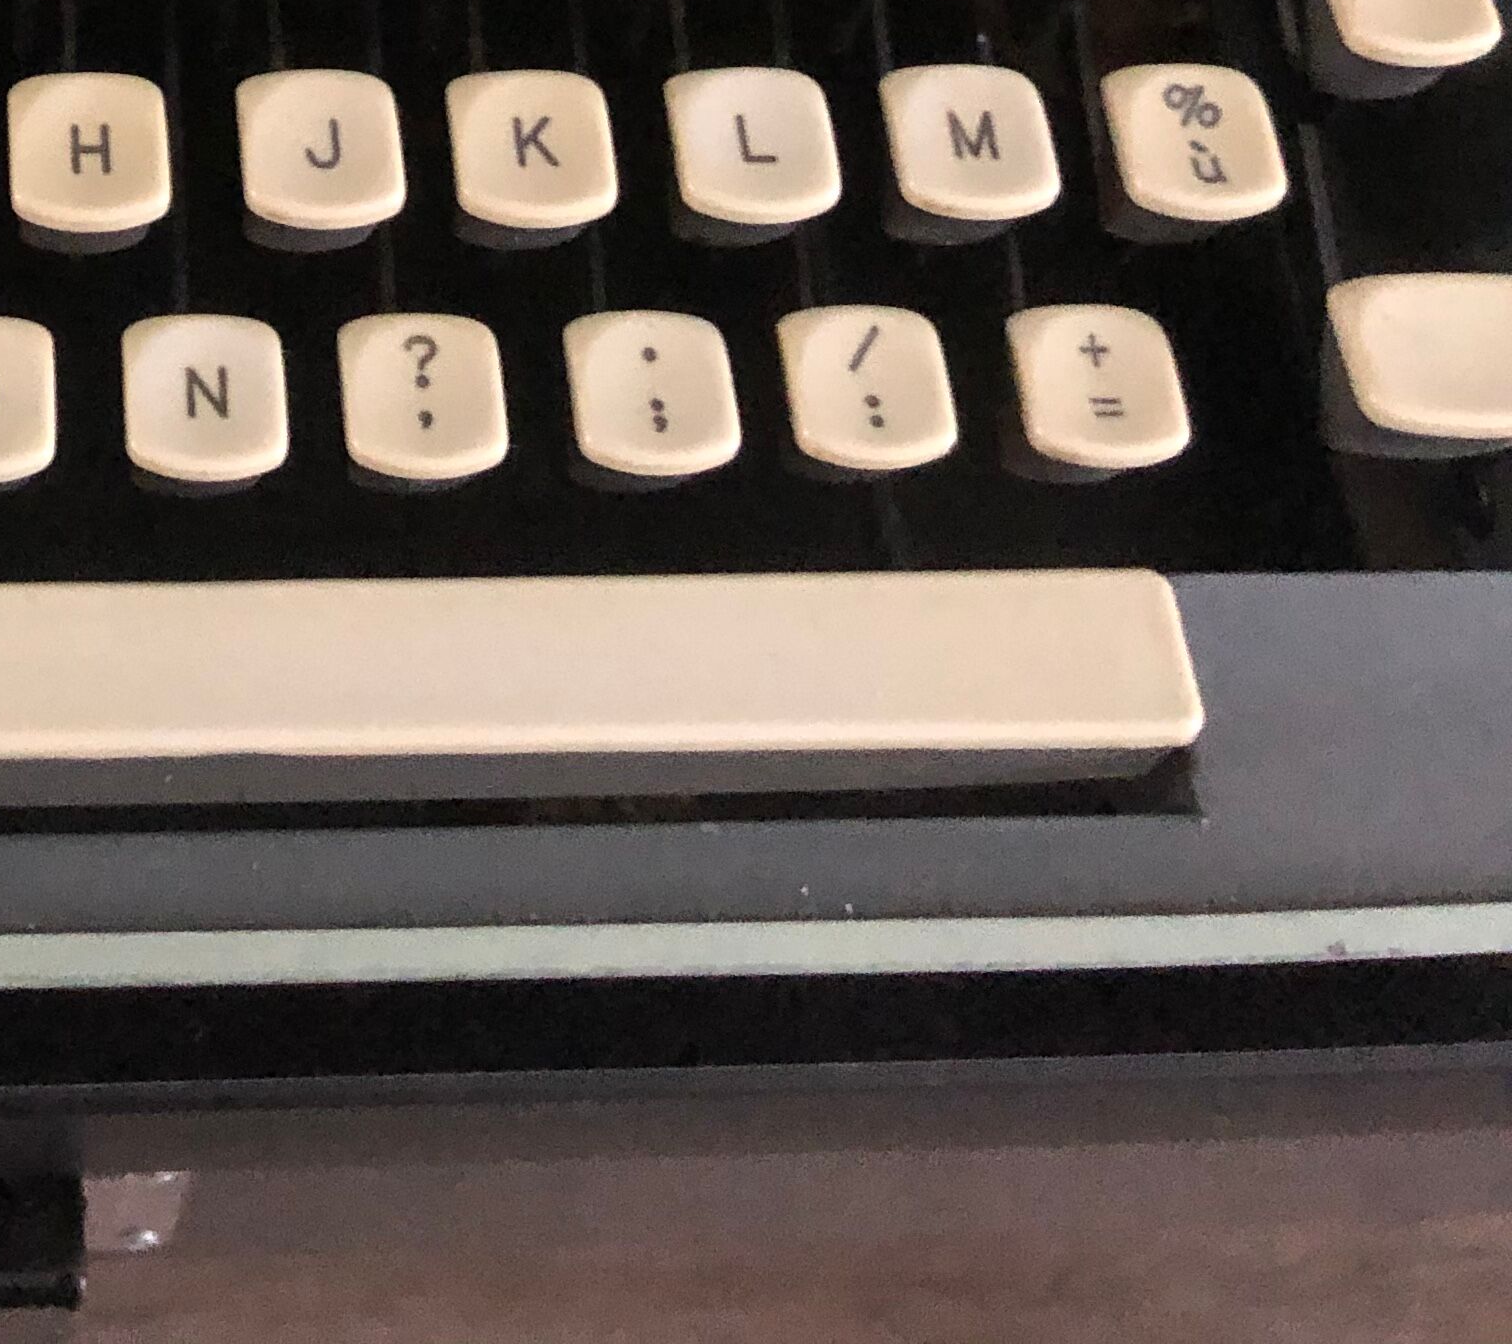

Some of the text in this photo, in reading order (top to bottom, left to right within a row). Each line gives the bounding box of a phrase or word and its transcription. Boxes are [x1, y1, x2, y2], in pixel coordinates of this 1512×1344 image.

[1162, 83, 1223, 130] %
[70, 123, 113, 175] H
[305, 118, 342, 170] J
[512, 116, 560, 168] K
[735, 114, 779, 165] L
[947, 110, 1001, 161] M
[404, 334, 439, 390] ?
[848, 324, 880, 373] /
[1079, 333, 1110, 369] +
[185, 366, 229, 419] N
[1090, 397, 1125, 418] =
